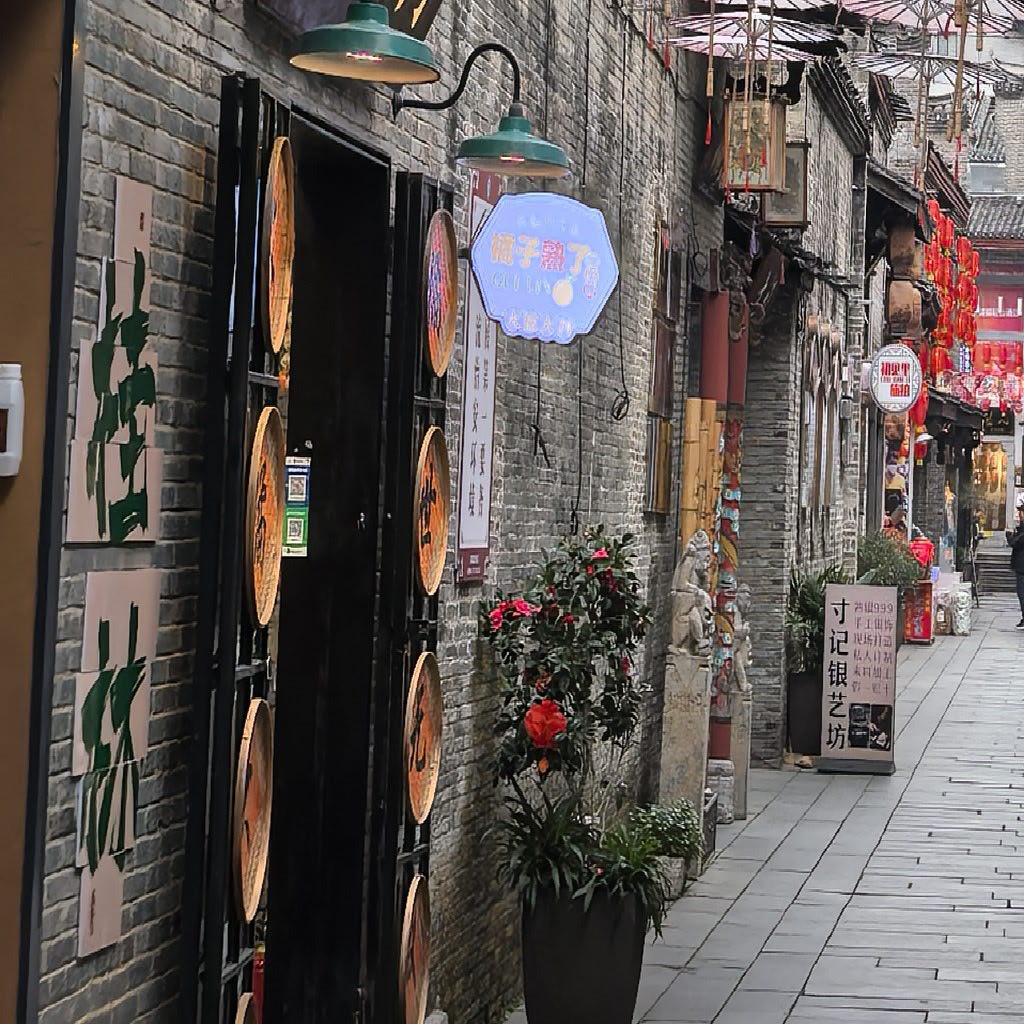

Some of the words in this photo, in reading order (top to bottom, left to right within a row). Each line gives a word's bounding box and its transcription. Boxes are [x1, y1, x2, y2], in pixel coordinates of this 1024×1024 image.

[826, 598, 850, 750] 寸记银艺坊
